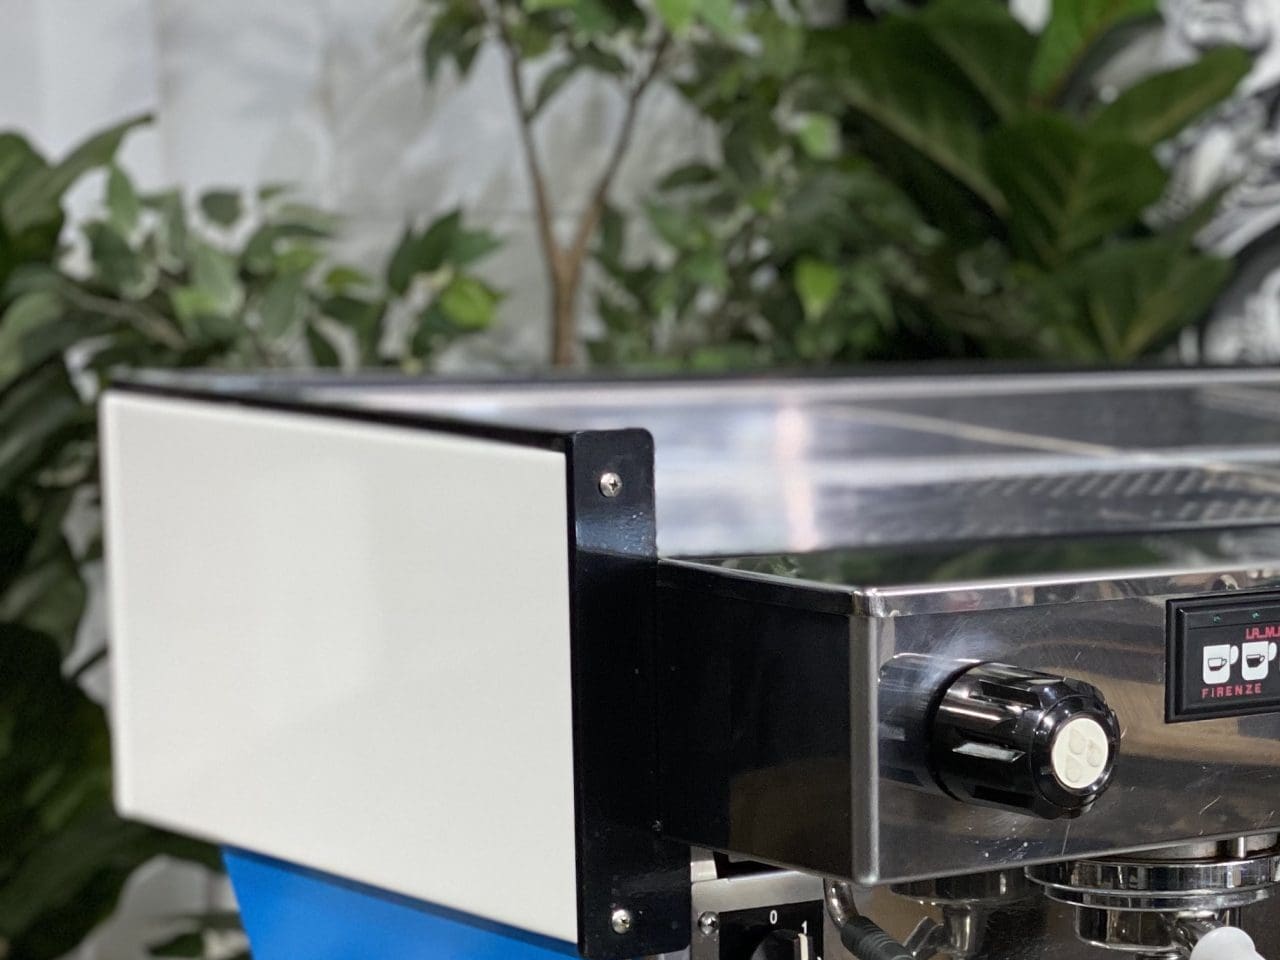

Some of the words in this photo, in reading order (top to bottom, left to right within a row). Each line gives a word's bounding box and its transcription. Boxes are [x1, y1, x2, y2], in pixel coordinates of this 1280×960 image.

[1202, 683, 1262, 699] FIRENZE
[769, 909, 778, 925] 0
[800, 920, 808, 934] 1
